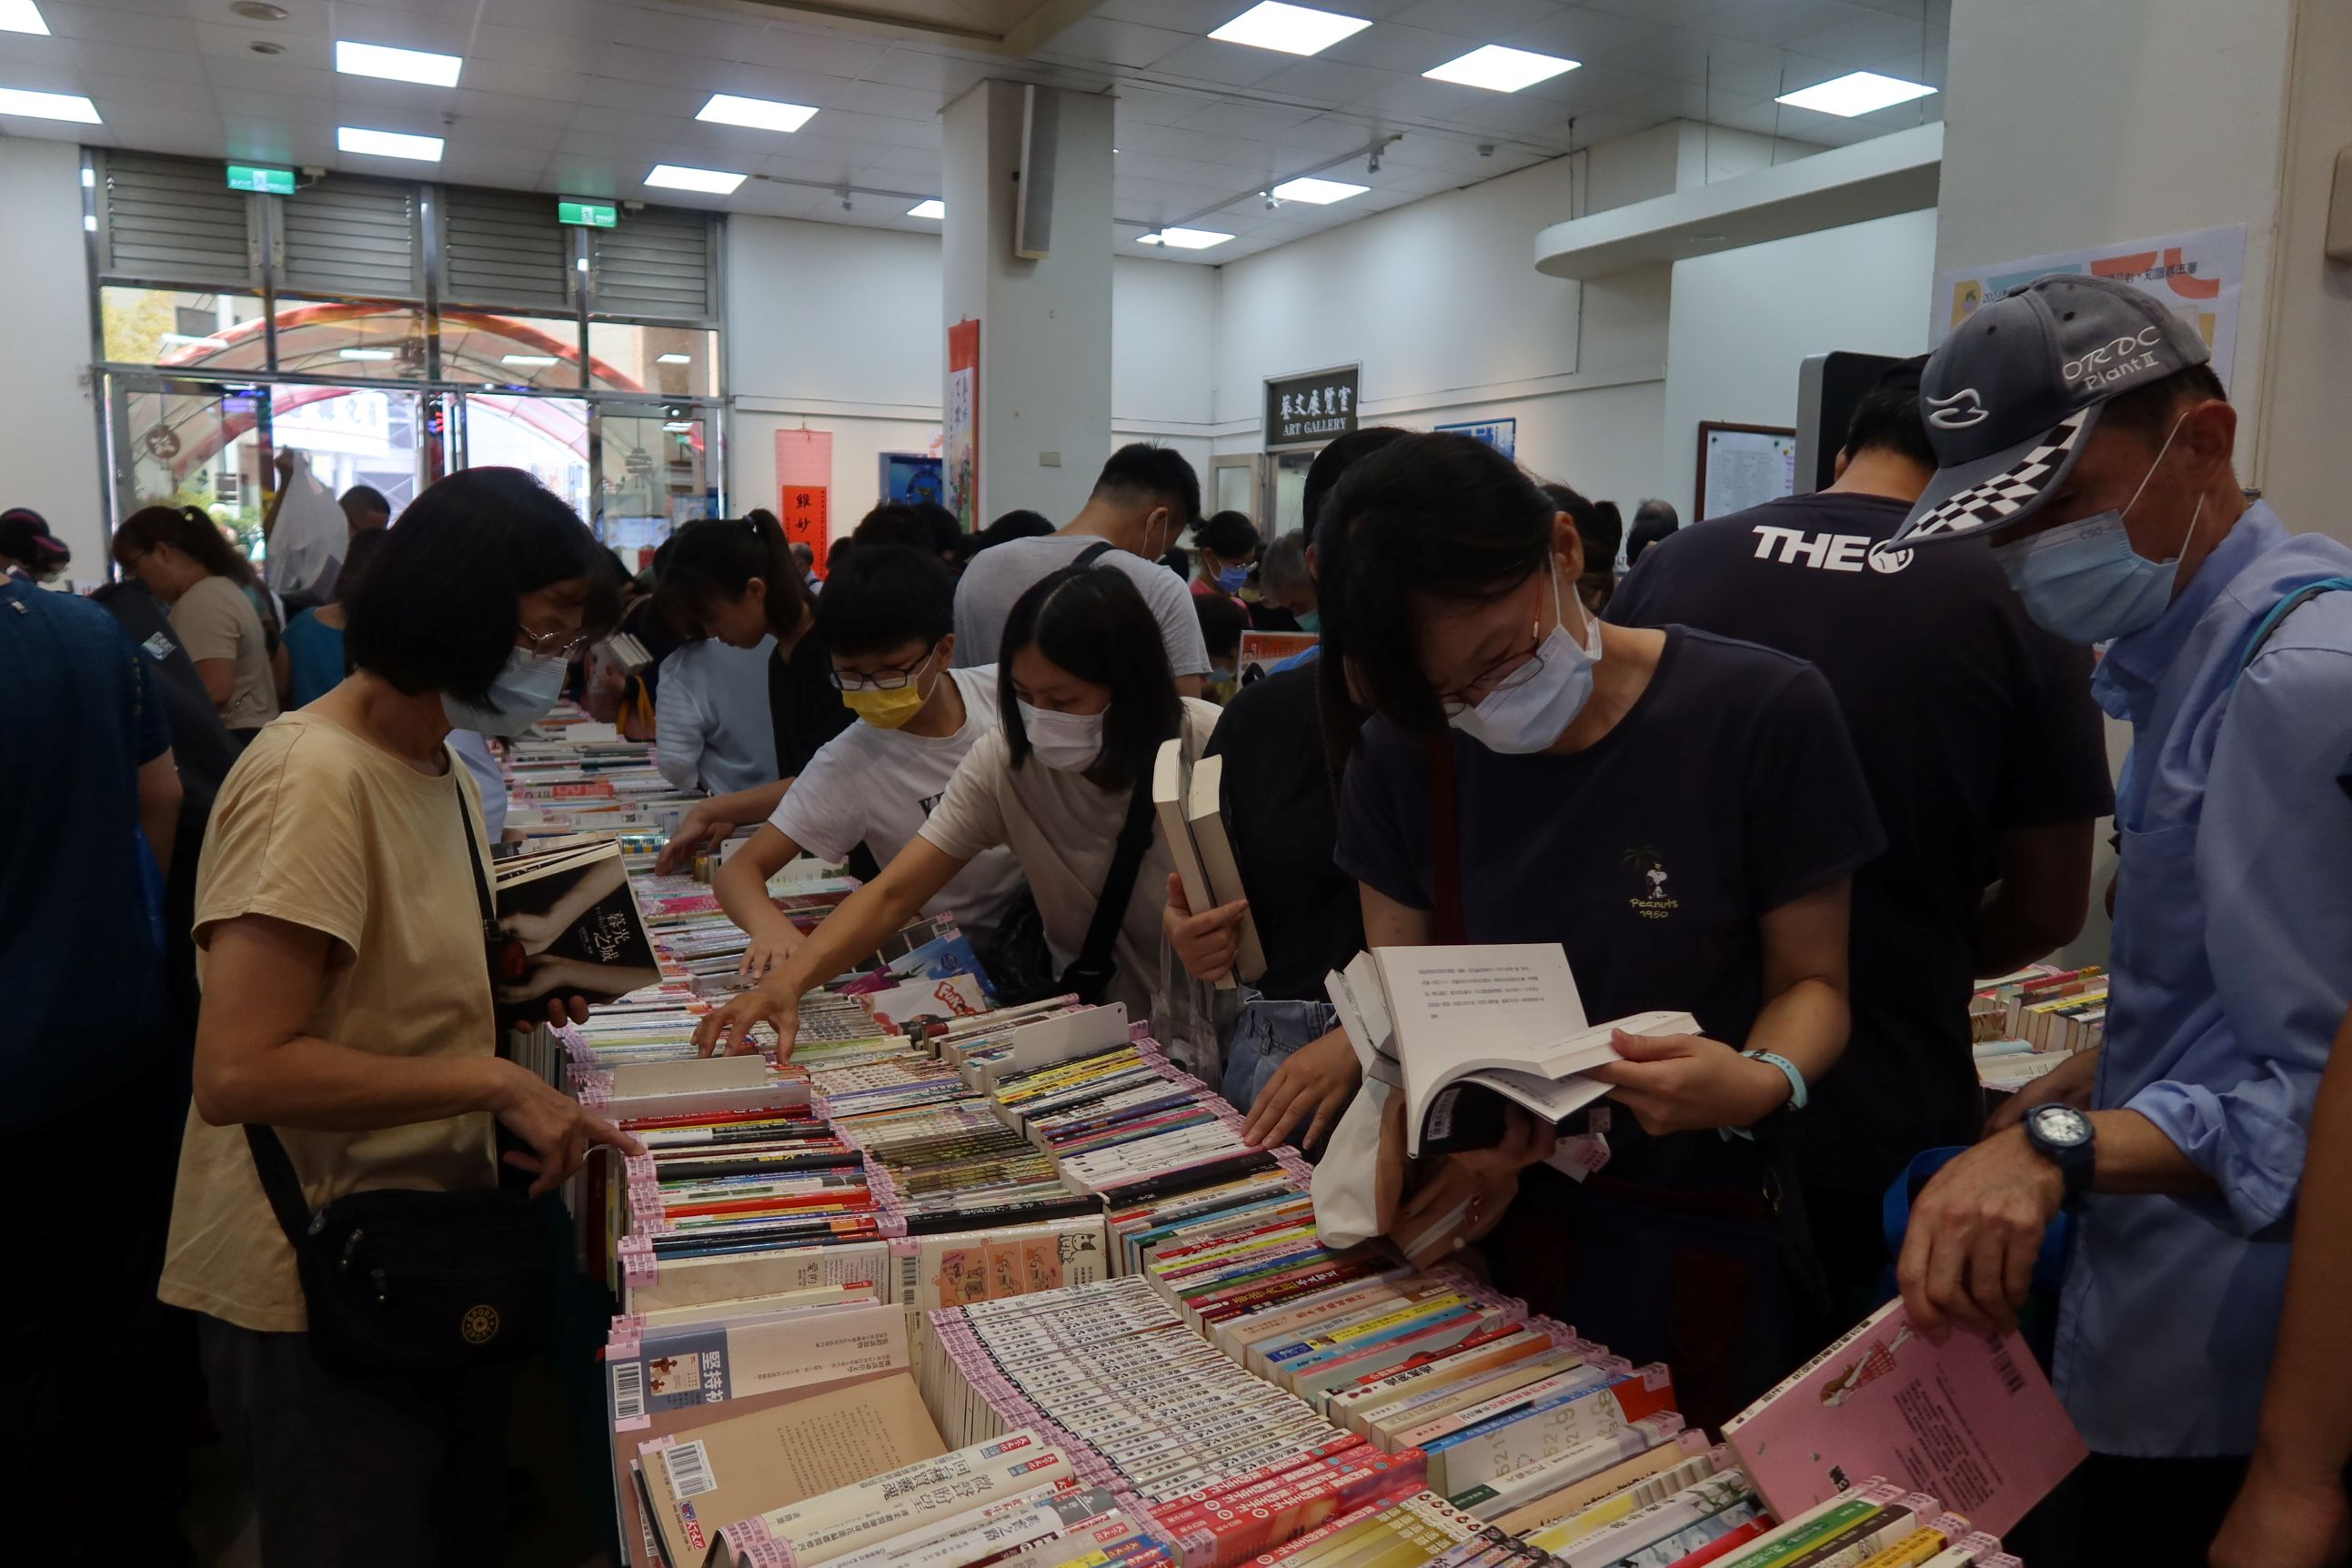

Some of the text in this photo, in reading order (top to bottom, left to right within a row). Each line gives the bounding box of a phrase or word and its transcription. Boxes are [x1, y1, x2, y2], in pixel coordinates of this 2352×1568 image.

[2085, 356, 2139, 391] Plant
[1281, 386, 1352, 420] 藝文展覽室
[1283, 417, 1345, 436] ART GALLERY
[1752, 525, 1871, 572] THE
[1630, 898, 1679, 909] Peanuts
[1640, 910, 1668, 919] 1950
[607, 910, 630, 946] 暮光
[593, 932, 619, 962] 之城
[804, 1261, 820, 1284] 愛的
[1000, 1435, 1029, 1452] 天下文化
[1027, 1453, 1056, 1470] 天下文化
[879, 1458, 971, 1501] 回台灣買靈魂
[909, 1472, 995, 1514] 微聲盼望
[684, 1519, 707, 1550] 天下文化
